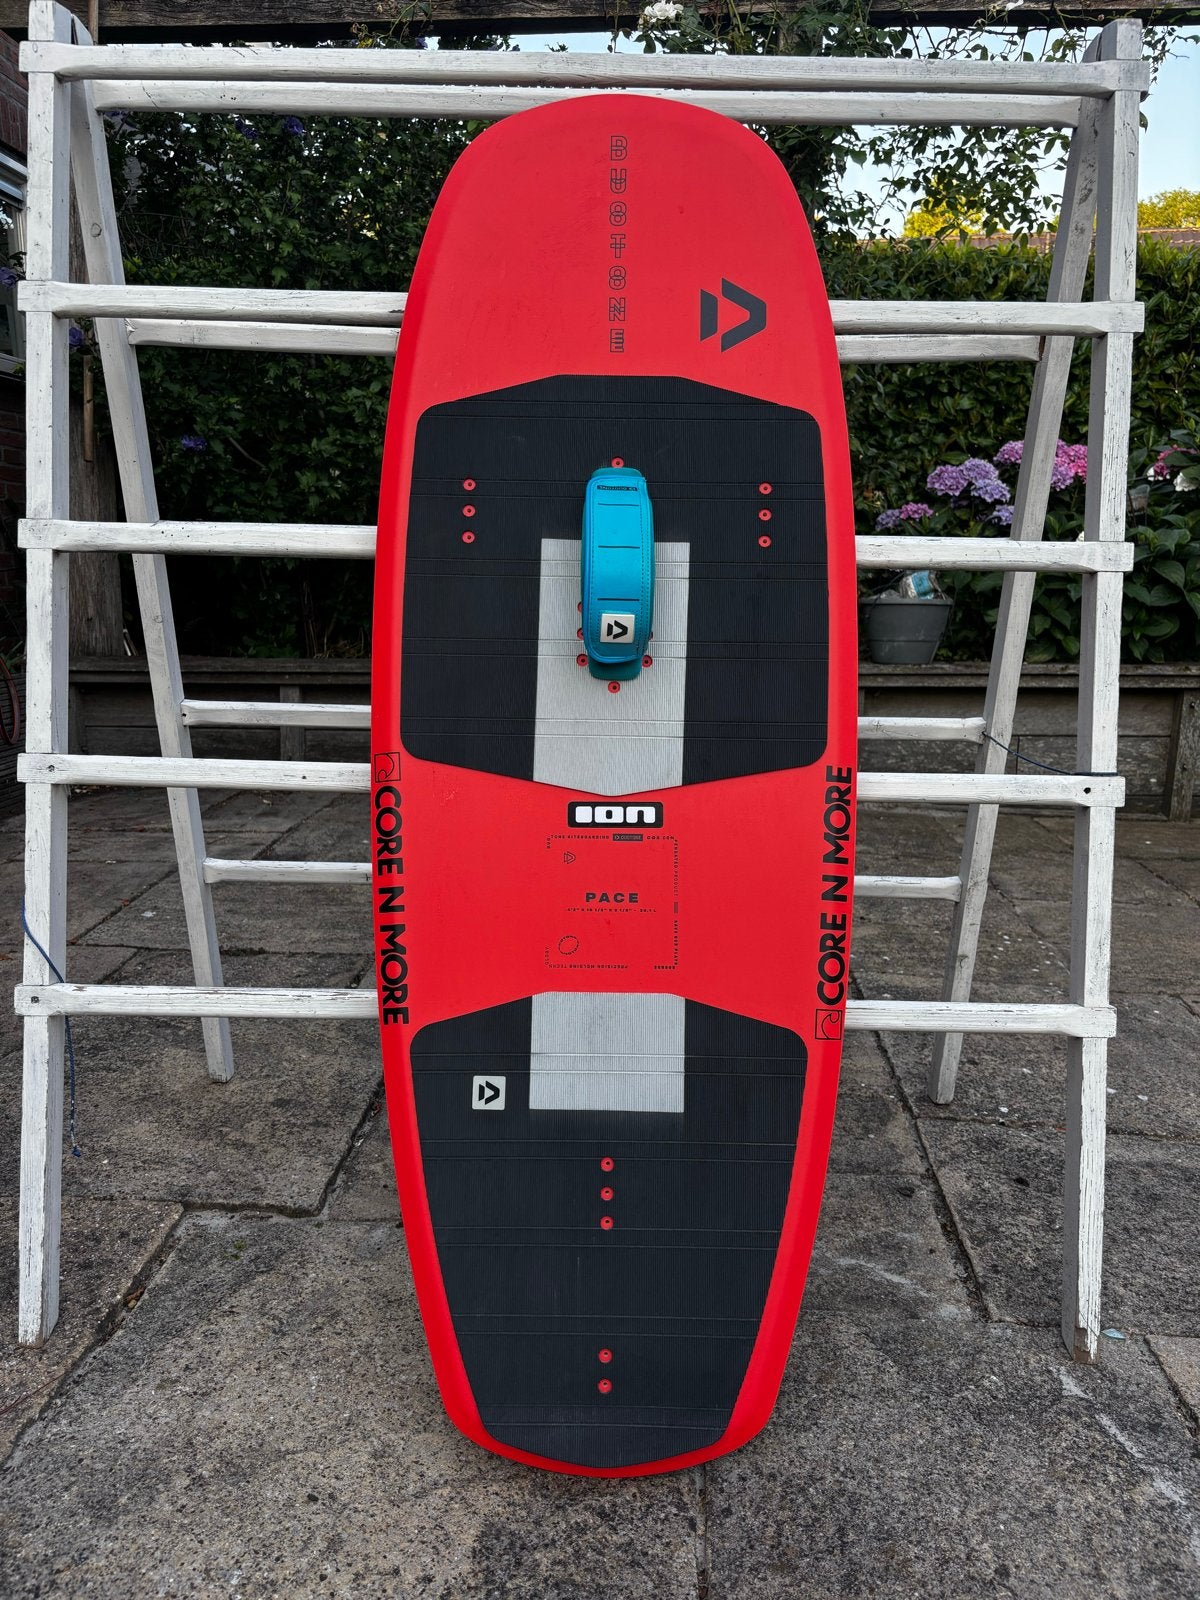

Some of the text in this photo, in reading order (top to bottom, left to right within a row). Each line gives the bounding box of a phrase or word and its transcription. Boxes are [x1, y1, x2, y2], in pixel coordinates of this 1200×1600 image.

[608, 135, 628, 353] DUOTONE
[374, 785, 410, 1026] CORE N MORE
[585, 892, 639, 903] PACE
[817, 765, 852, 1006] CORE N MORE
